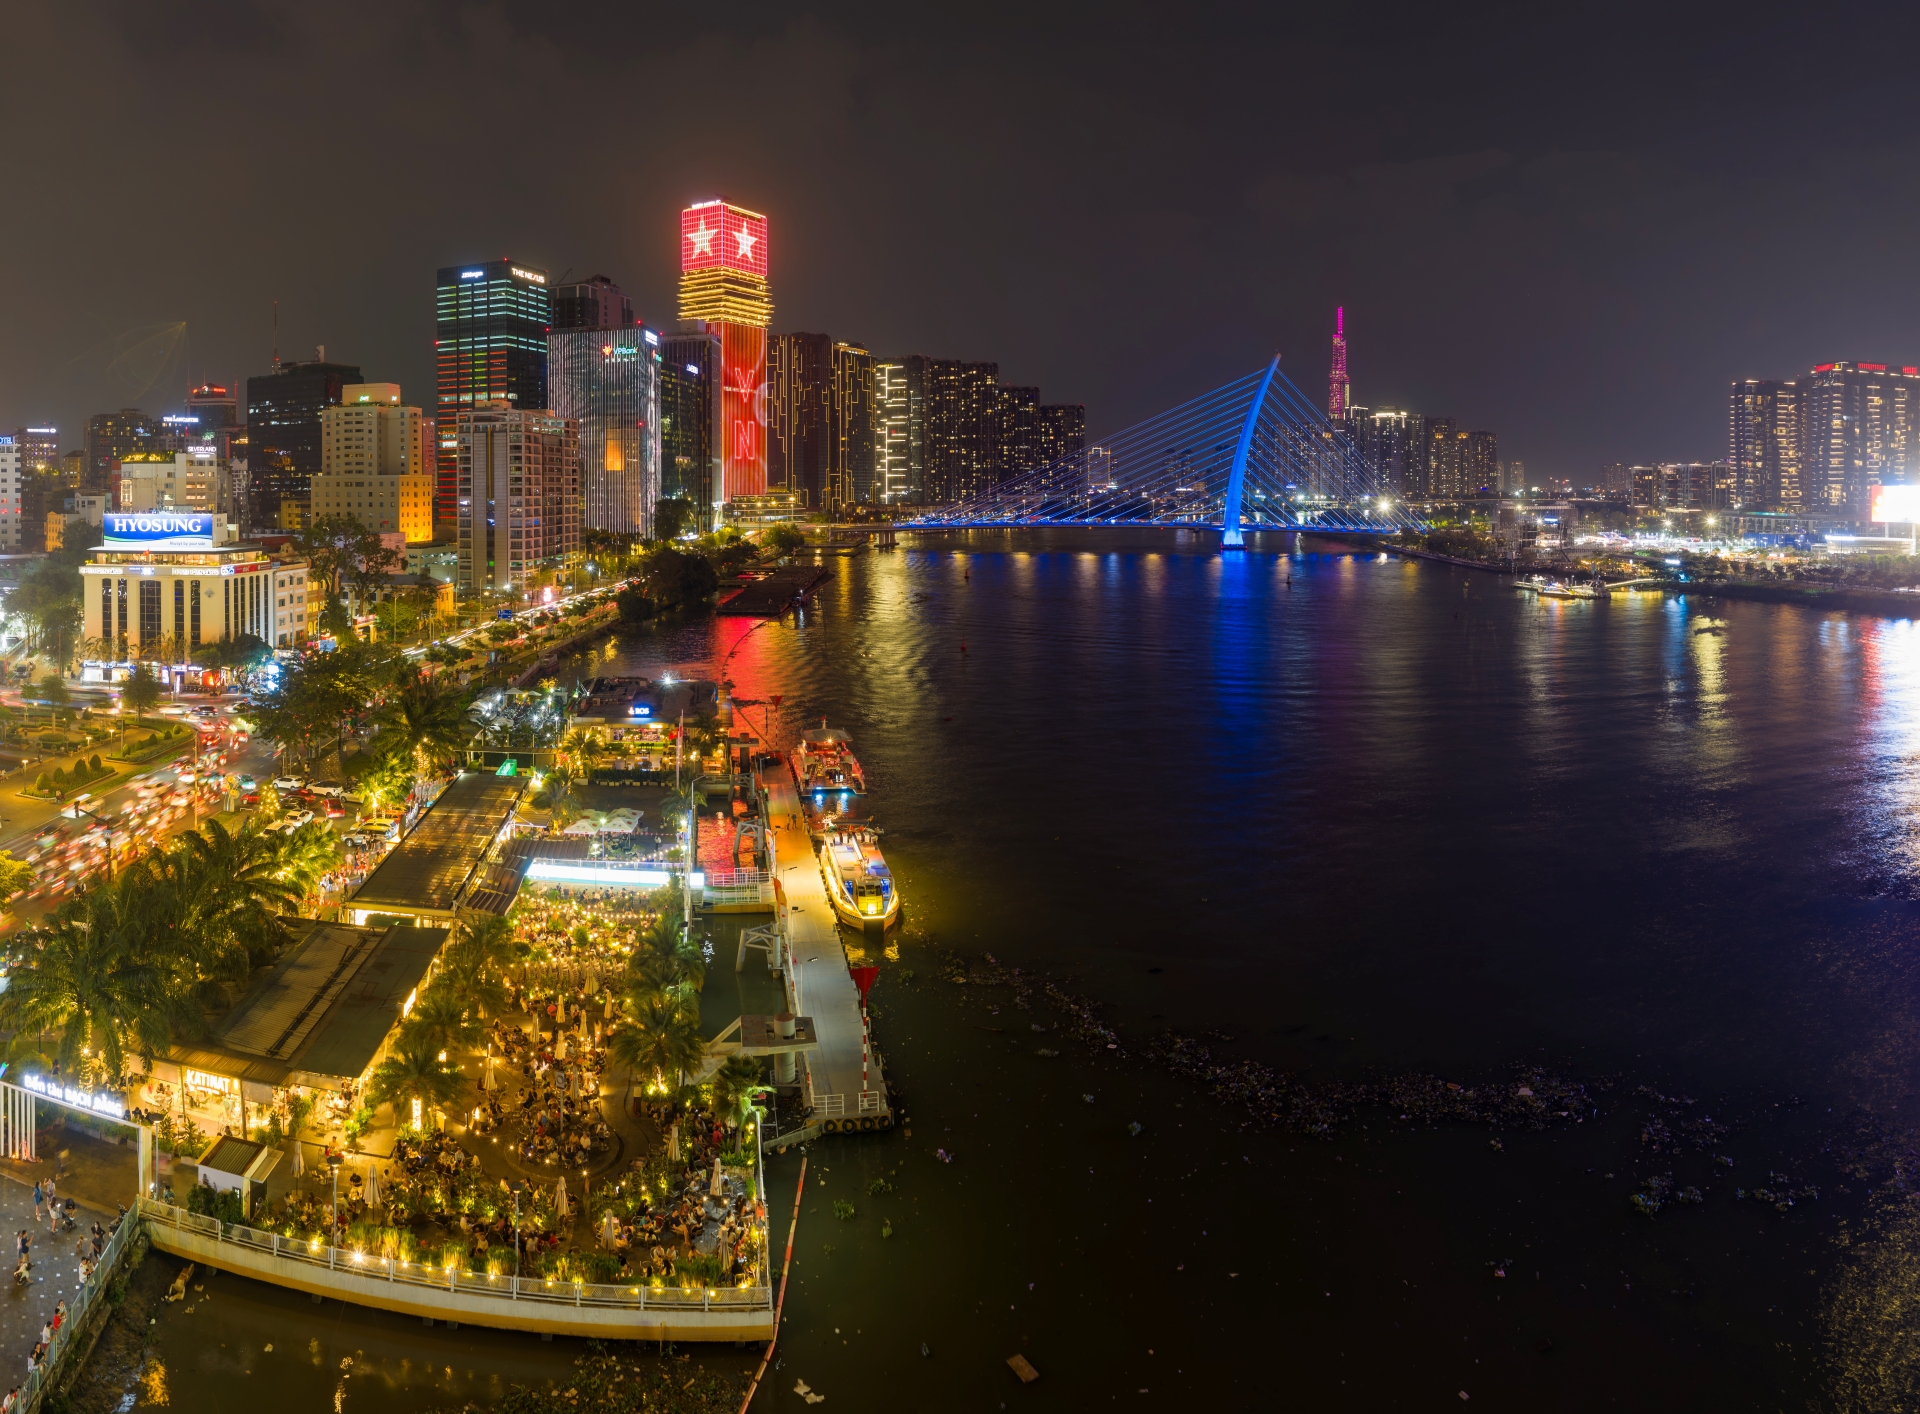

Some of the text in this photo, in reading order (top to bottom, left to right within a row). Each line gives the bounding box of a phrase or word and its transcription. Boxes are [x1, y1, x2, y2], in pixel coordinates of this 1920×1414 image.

[512, 267, 525, 278] THE
[613, 347, 638, 355] VPBank
[113, 518, 202, 533] HYOSUNG
[187, 1069, 230, 1094] KATINAT
